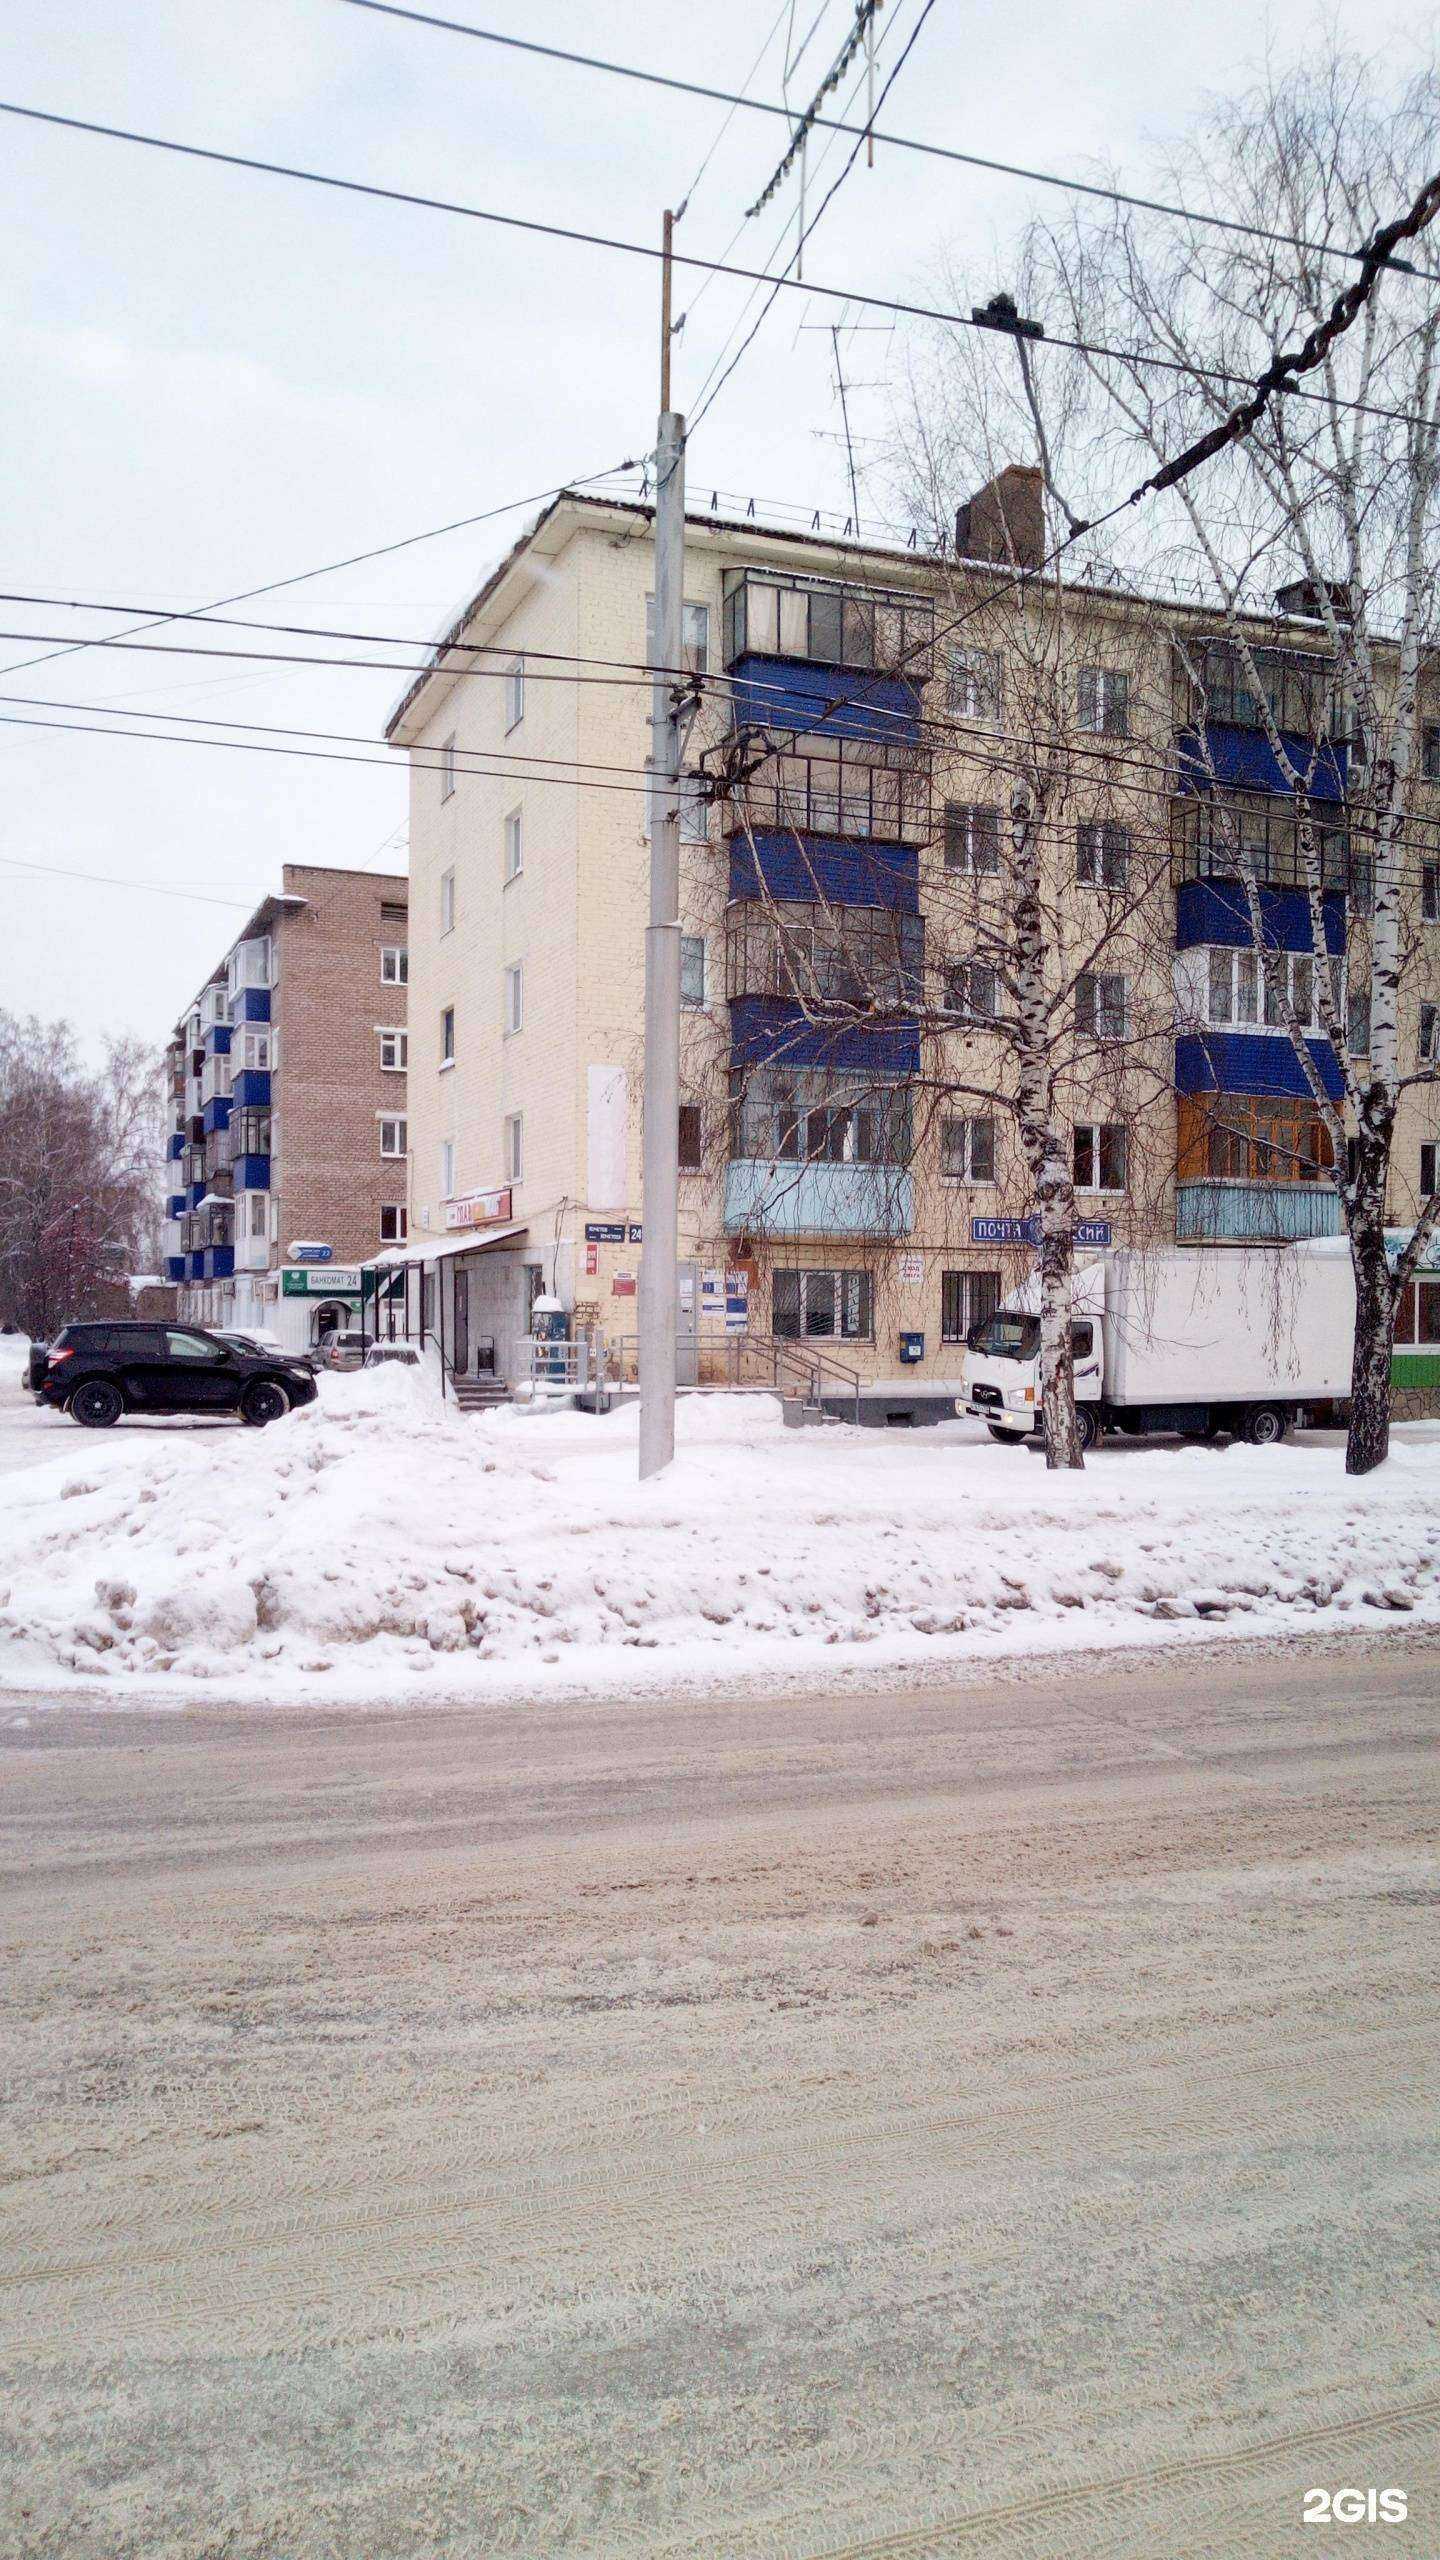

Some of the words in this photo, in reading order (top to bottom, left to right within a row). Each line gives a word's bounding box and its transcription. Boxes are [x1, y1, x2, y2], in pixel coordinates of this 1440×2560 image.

[631, 1228, 642, 1240] 24
[978, 1221, 1021, 1238] ПОЧТА
[310, 1275, 344, 1285] БАНКОМАТ
[346, 1274, 357, 1286] 24
